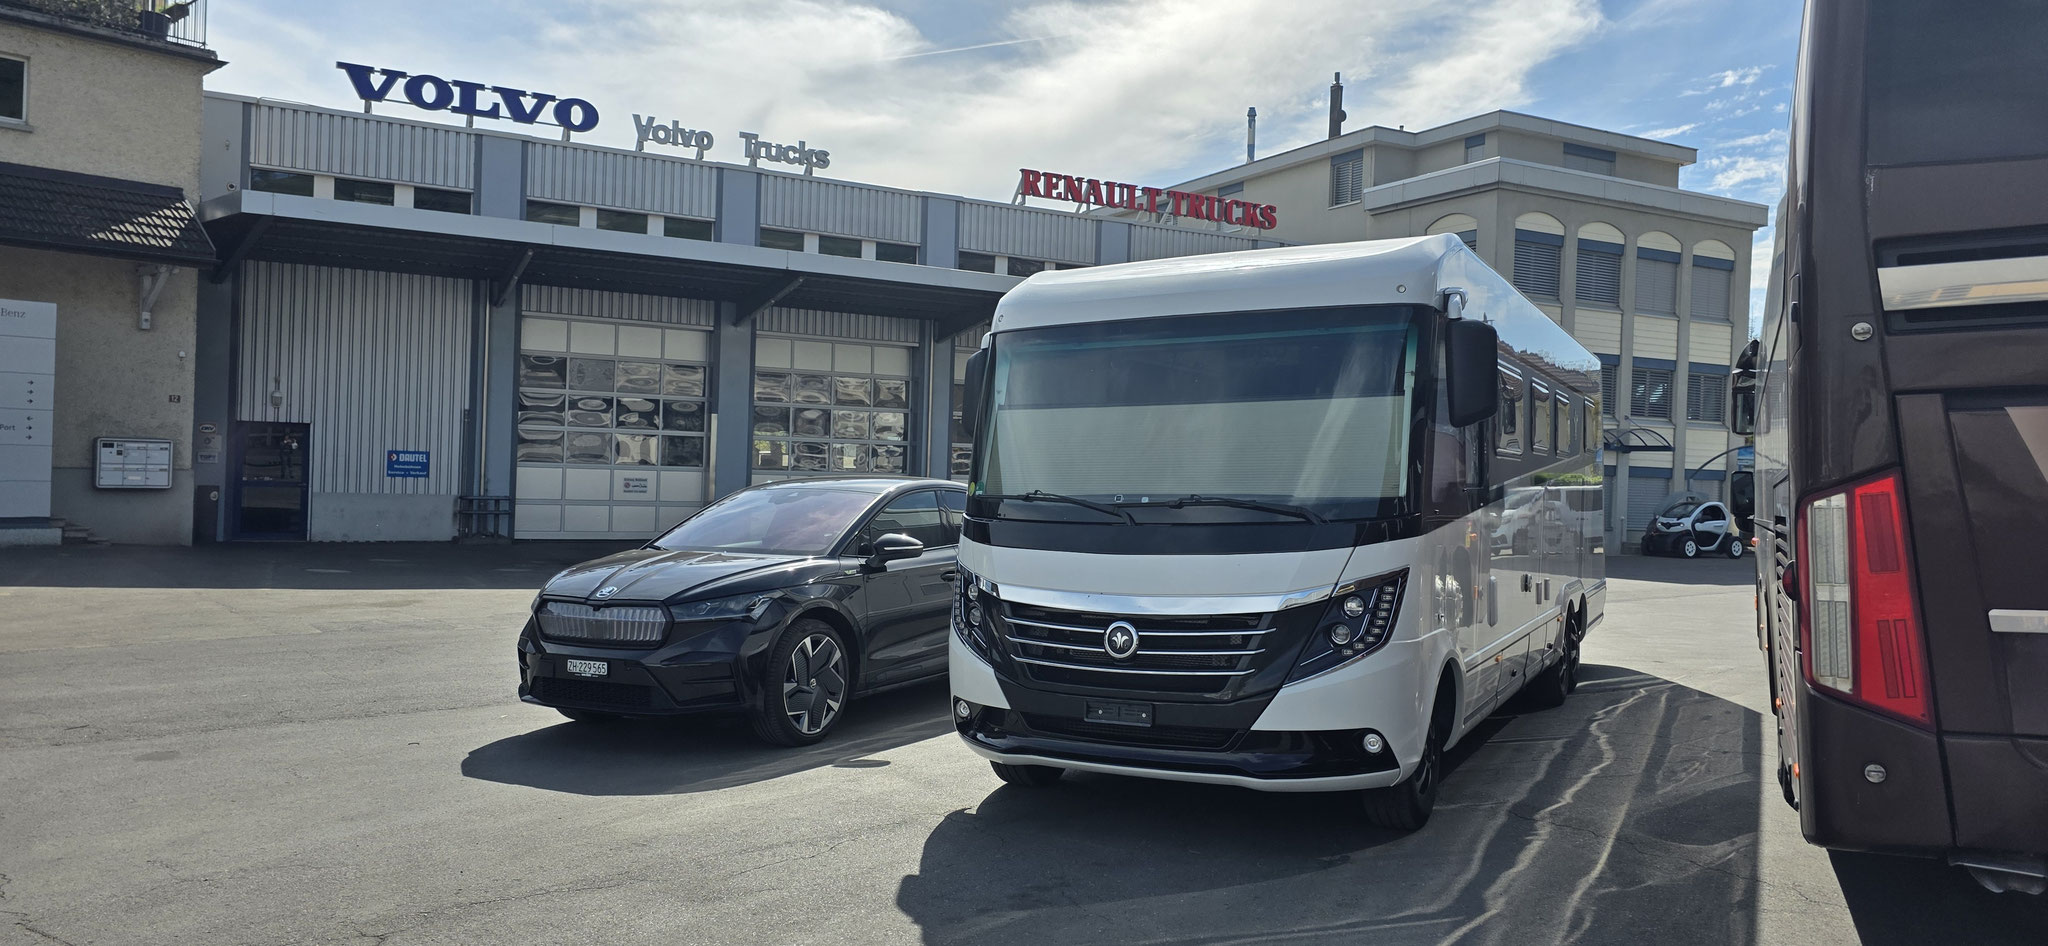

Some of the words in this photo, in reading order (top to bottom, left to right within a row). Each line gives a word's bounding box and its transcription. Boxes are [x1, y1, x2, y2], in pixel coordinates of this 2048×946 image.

[335, 61, 600, 132] VOLVO
[632, 113, 714, 151] Volvo
[739, 131, 831, 170] Trucks
[1020, 168, 1163, 213] RENAULT
[1167, 190, 1278, 231] TRUCKS
[0, 307, 27, 319] Benz
[399, 453, 427, 462] DAUTEL
